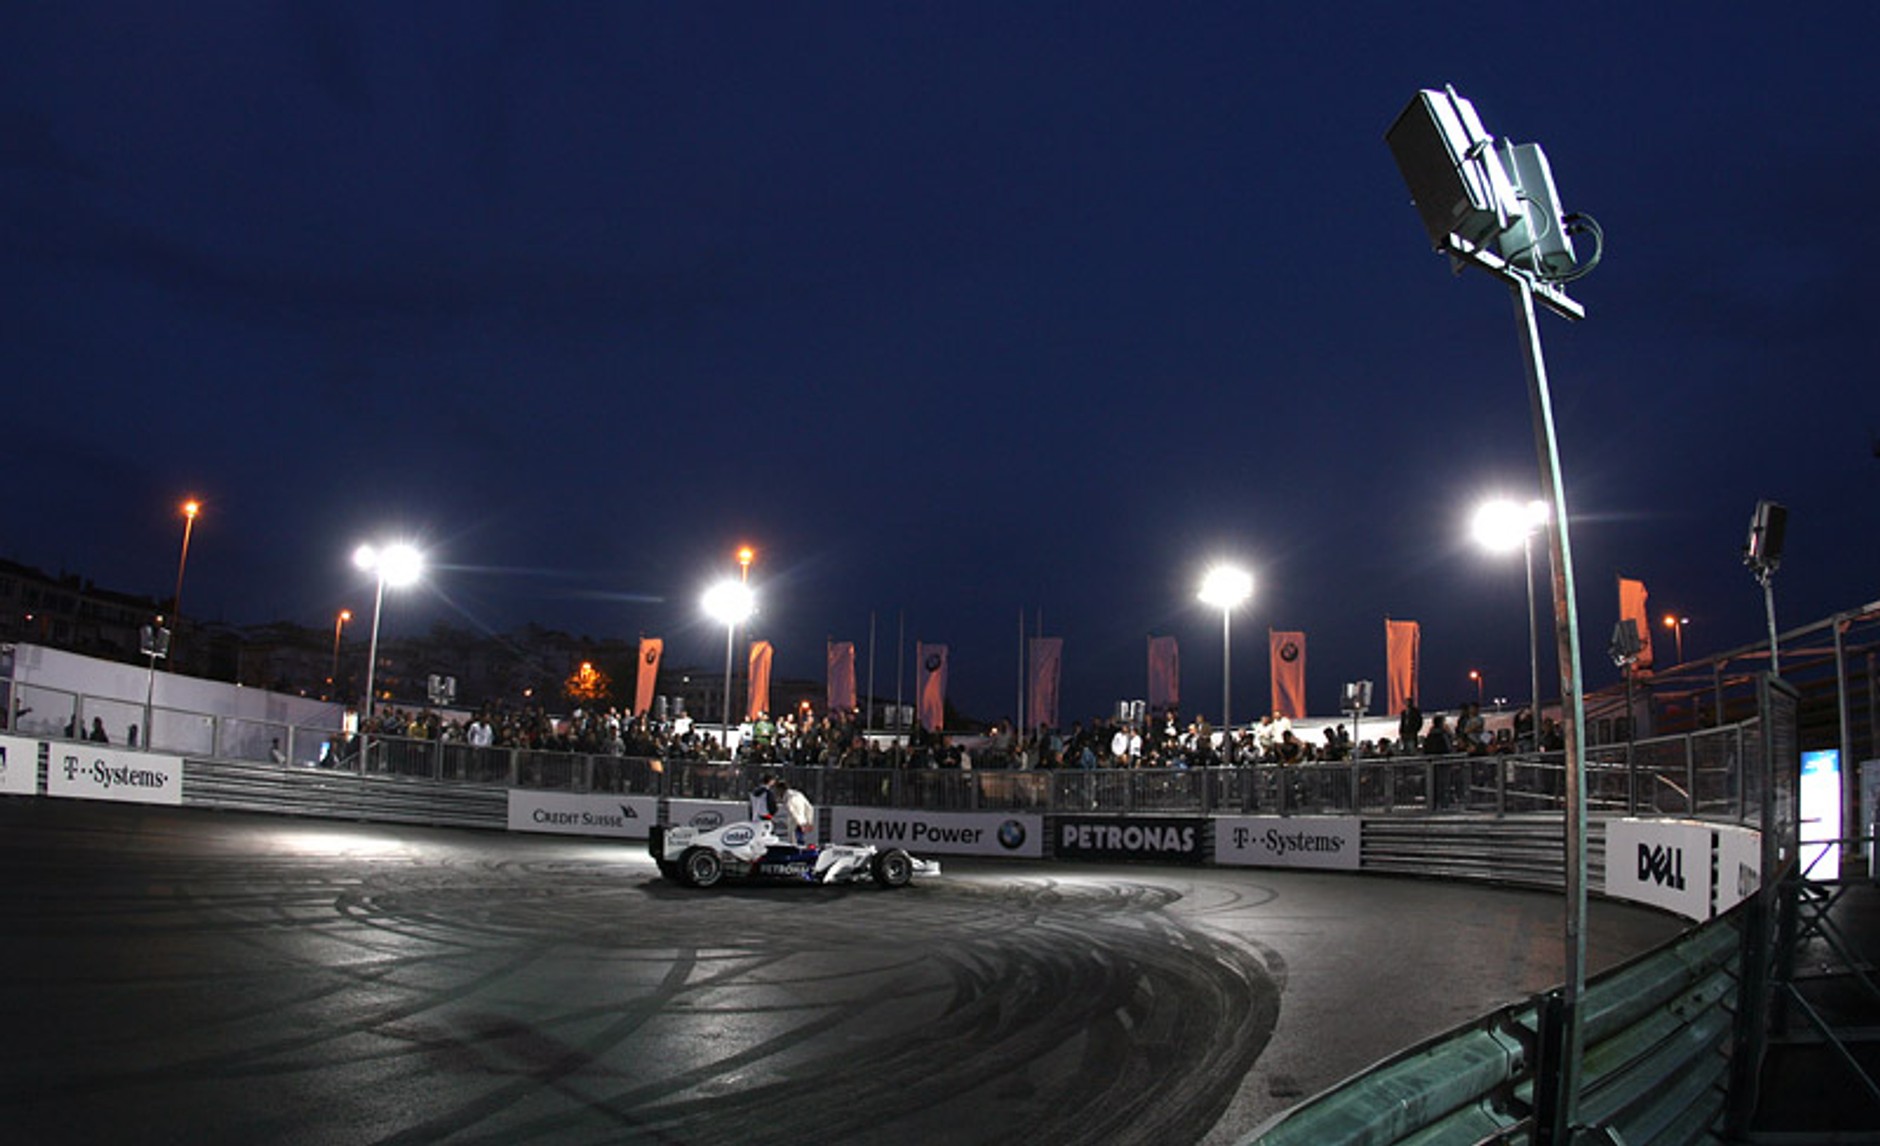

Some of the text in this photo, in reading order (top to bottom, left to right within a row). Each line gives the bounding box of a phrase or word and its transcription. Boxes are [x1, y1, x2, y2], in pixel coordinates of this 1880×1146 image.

[846, 819, 983, 844] BMW Power
[1062, 824, 1195, 852] PETRONAS
[1638, 843, 1686, 891] DELL
